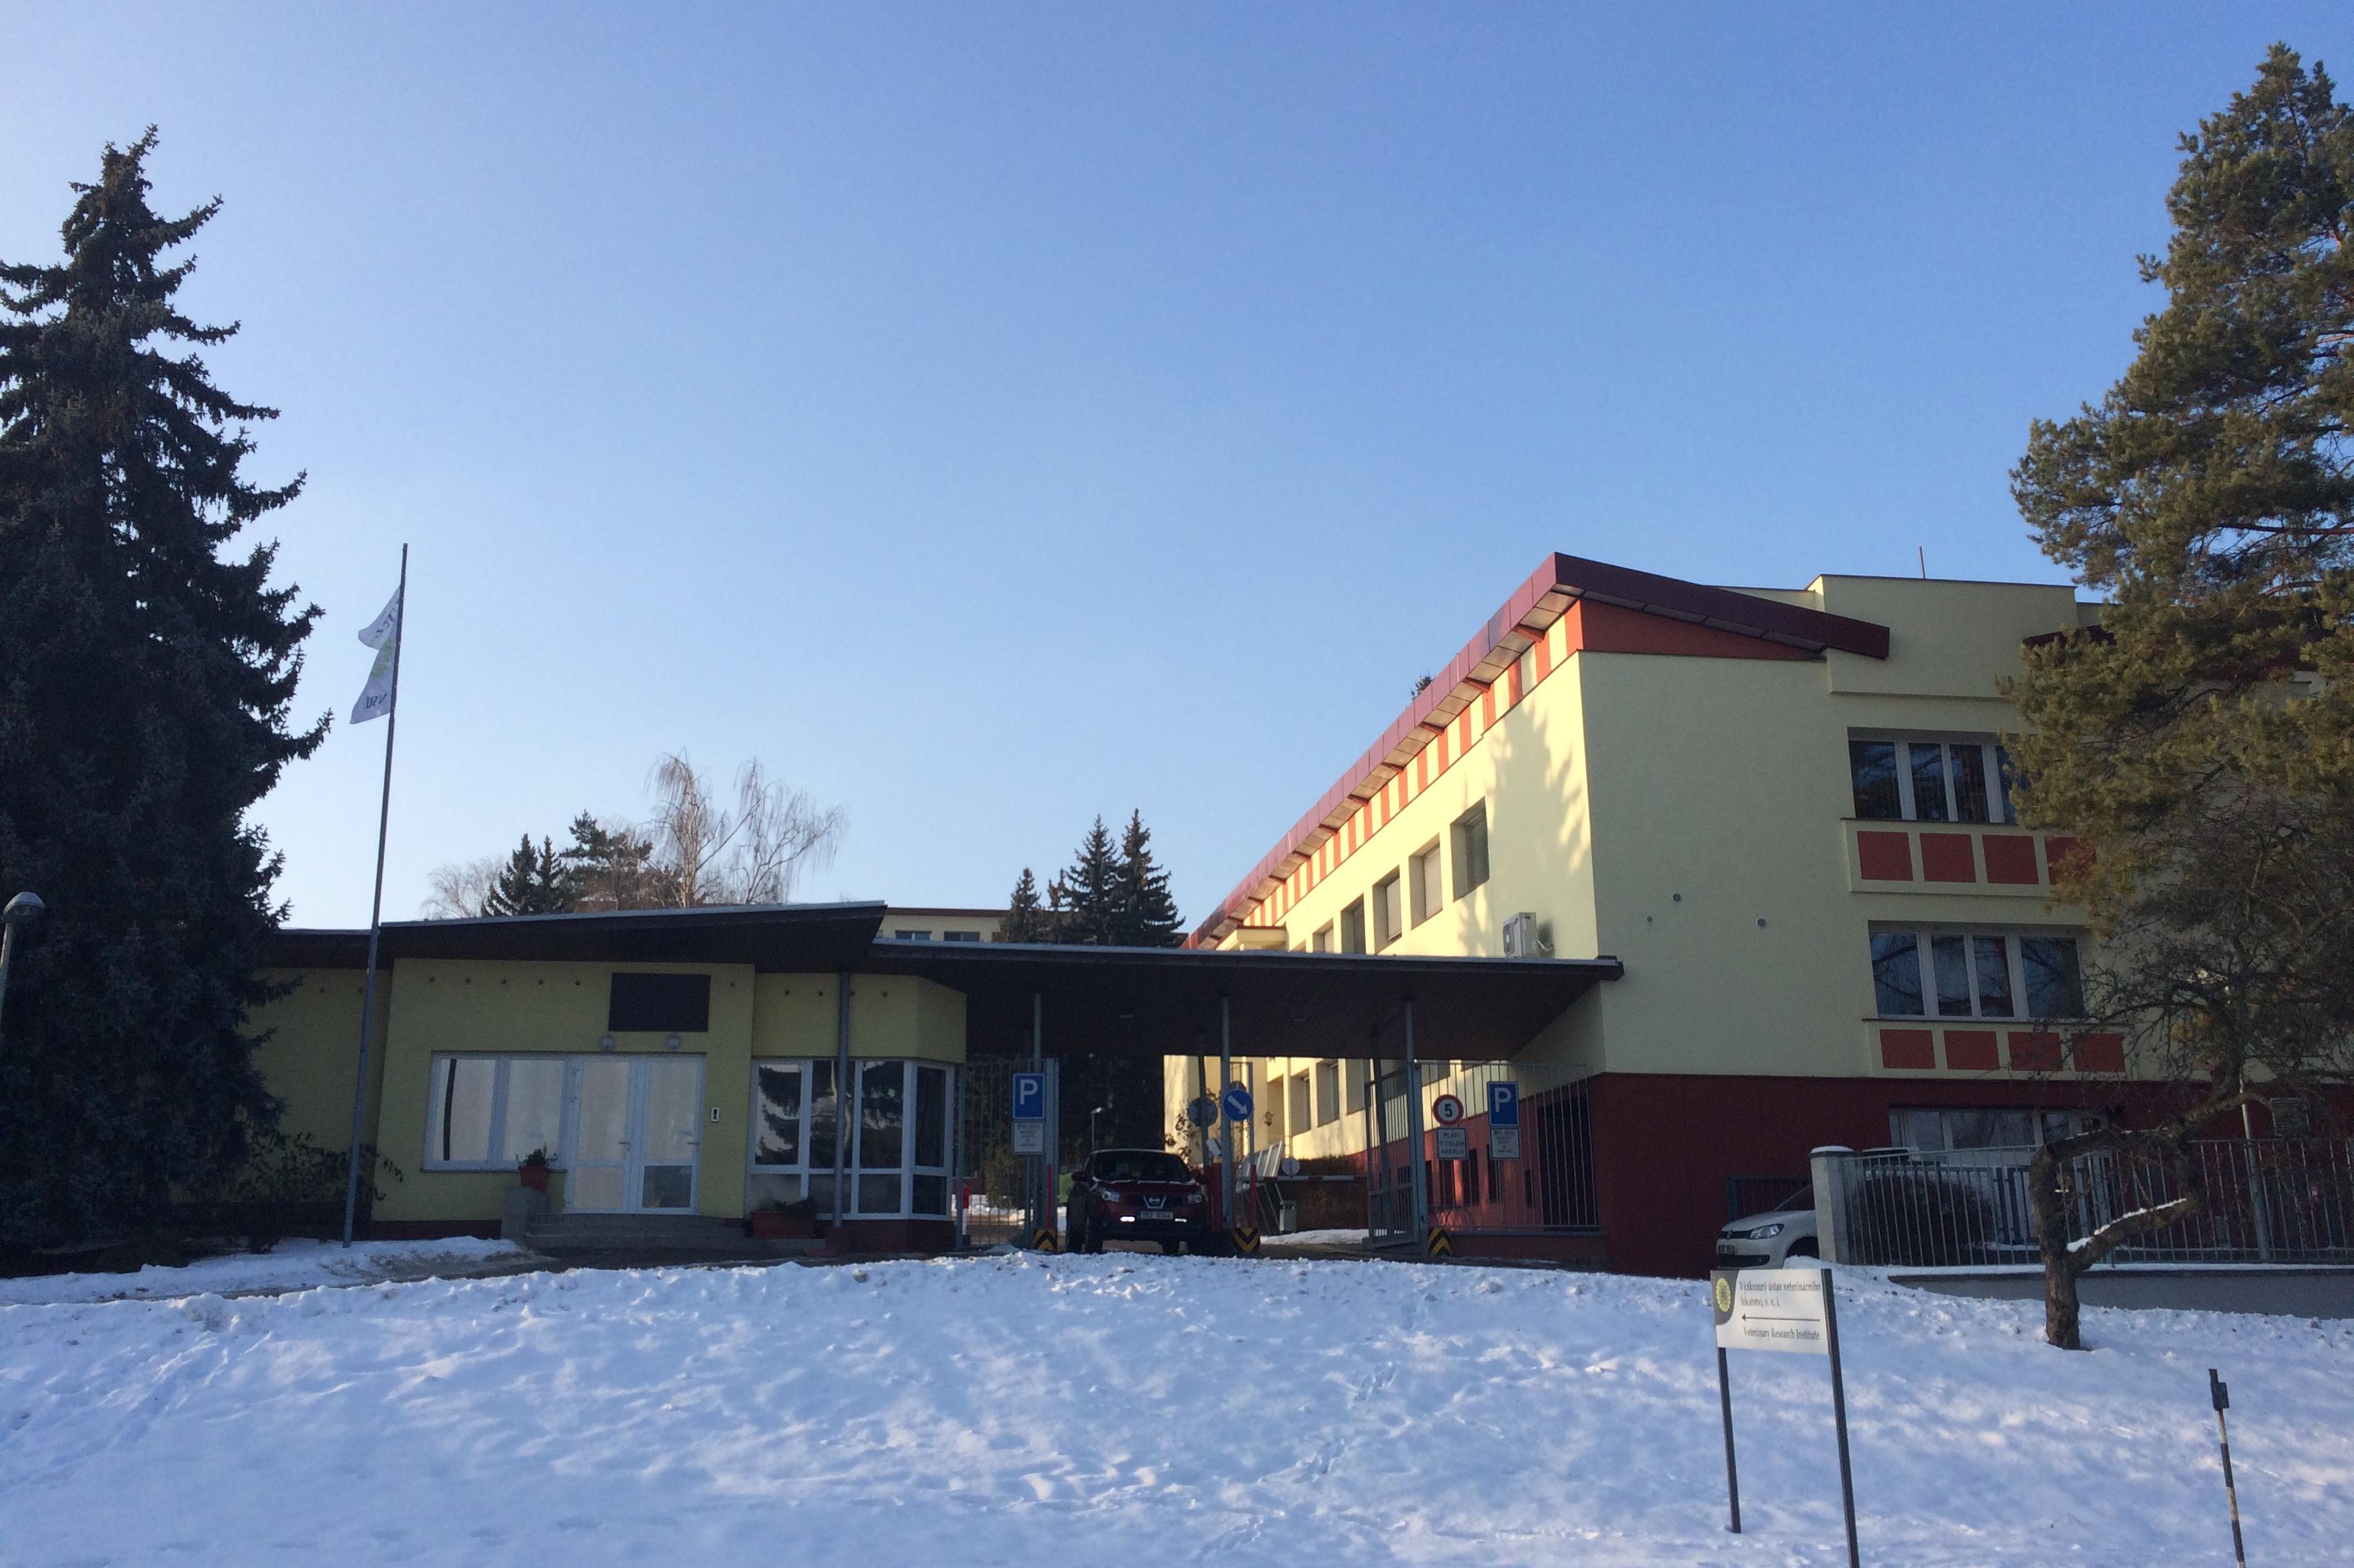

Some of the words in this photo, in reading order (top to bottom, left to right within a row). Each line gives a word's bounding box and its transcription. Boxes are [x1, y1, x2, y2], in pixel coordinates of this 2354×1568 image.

[1020, 1079, 1038, 1105] P
[1494, 1087, 1512, 1112] P
[1445, 1104, 1452, 1117] 5
[1768, 1282, 1782, 1292] ústav
[1743, 1326, 1770, 1340] Veterinary
[1771, 1327, 1794, 1339] Research
[1796, 1329, 1820, 1340] Institute
